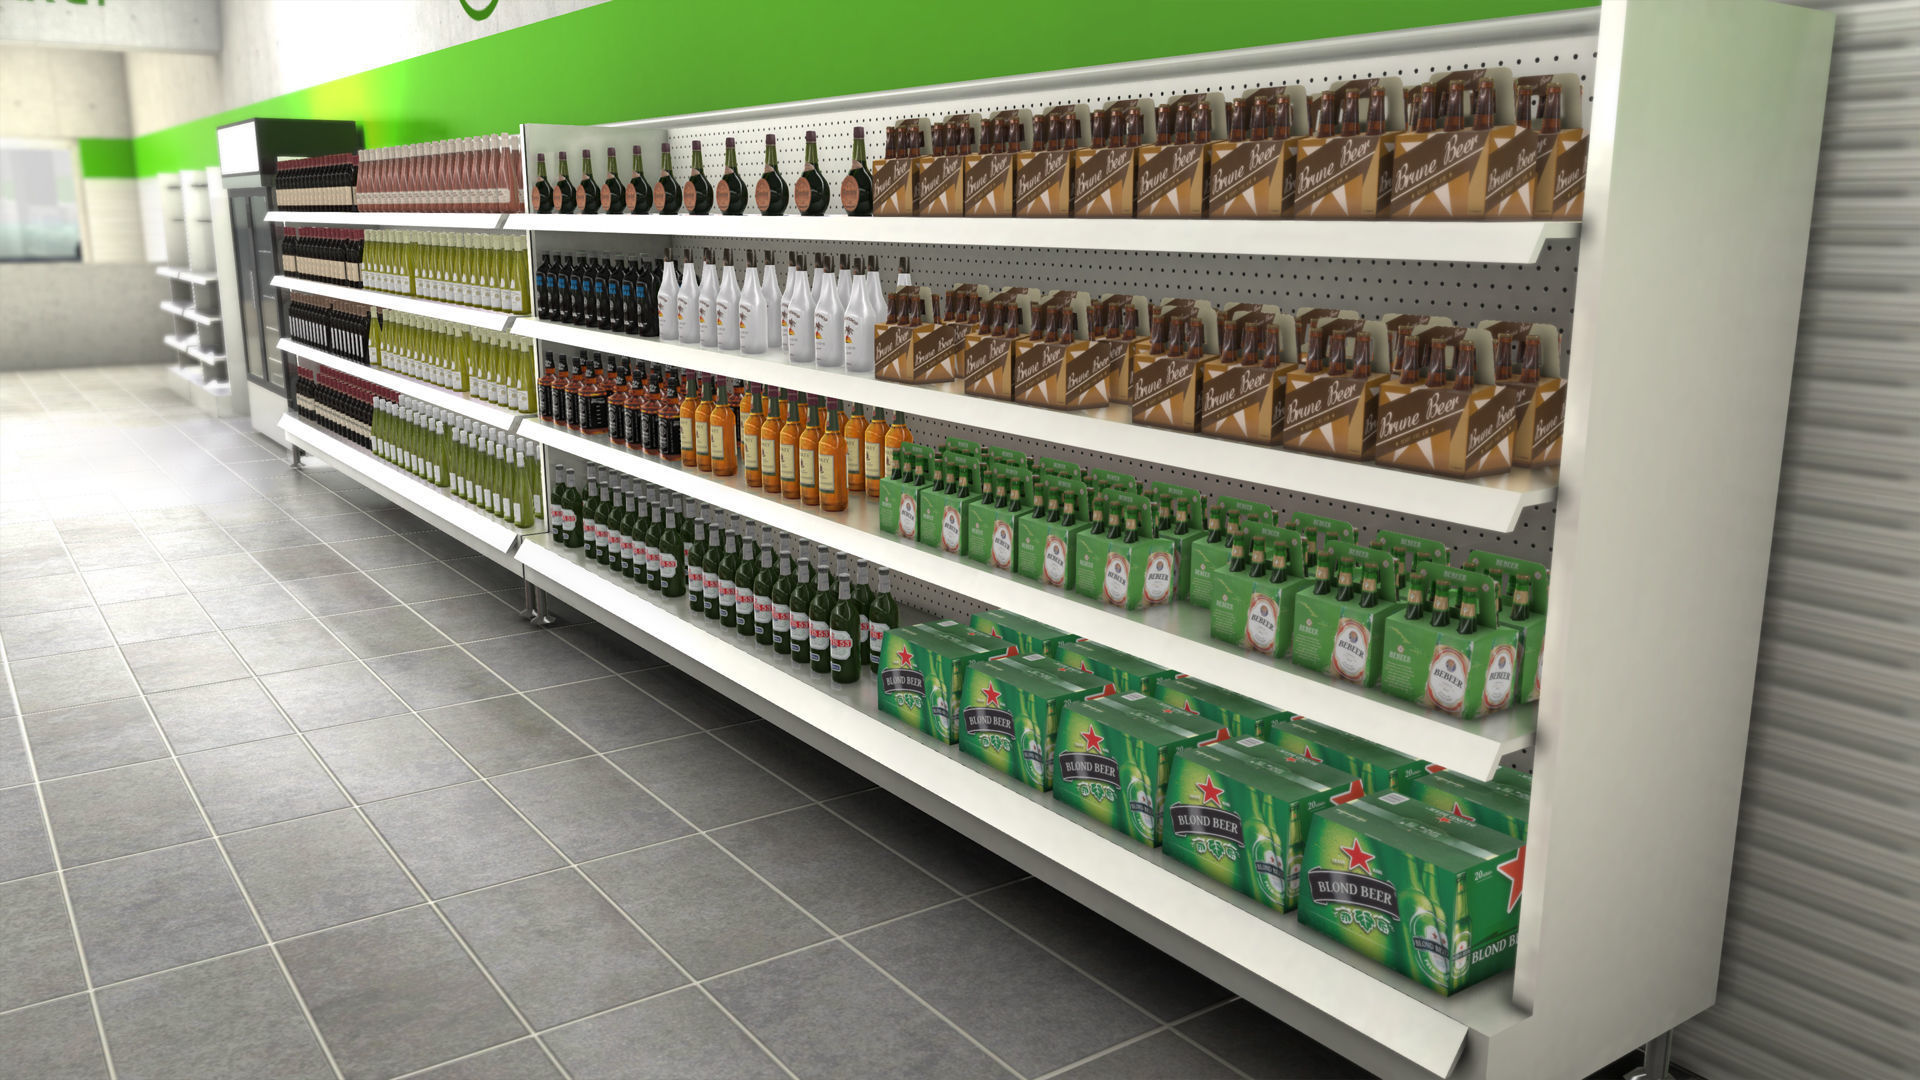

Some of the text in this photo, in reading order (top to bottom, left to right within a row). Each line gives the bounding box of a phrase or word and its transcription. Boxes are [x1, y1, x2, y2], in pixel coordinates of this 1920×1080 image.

[1018, 152, 1064, 196] Brune Beer
[1077, 150, 1127, 196] Brune Beer
[1139, 147, 1196, 195] Brune Beer
[1212, 143, 1276, 195] Brune Beer
[1298, 162, 1335, 194] Brune
[1340, 139, 1371, 169] Beer
[1394, 158, 1437, 193] Brune
[1443, 133, 1479, 166] Beer
[1488, 148, 1536, 192] Brune Beer
[966, 156, 1008, 198] Brune Beer
[1556, 169, 1580, 193] Brune
[966, 339, 1006, 375] Brune Beer
[1016, 346, 1061, 383] Brune Beer
[1067, 356, 1109, 390] Brune Beer
[1134, 360, 1189, 400] Brune Beer
[1204, 369, 1265, 412] Brune Beer
[1286, 398, 1322, 425] Brune
[1327, 379, 1357, 407] Beer
[1379, 411, 1420, 440] Brune
[1426, 392, 1460, 420] Beer
[1468, 405, 1516, 451] Brune Beer
[1534, 416, 1558, 442] Brune
[995, 538, 1010, 551] BEBEER
[1349, 548, 1369, 559] BEBEER
[1401, 537, 1422, 548] BEBEER
[1047, 553, 1064, 567] BEBEER
[1496, 559, 1519, 570] BEBEER
[1108, 571, 1126, 586] BEBEER
[1148, 572, 1169, 582] BEBEER
[1444, 570, 1467, 582] BEBEER
[1250, 614, 1274, 632] BEBEER
[1338, 639, 1364, 659] BEBEER
[1389, 651, 1411, 663] BEBEER
[886, 675, 922, 688] BLOND BEER
[1433, 668, 1464, 689] BEBEER
[1489, 671, 1511, 681] BEBEER
[969, 716, 1012, 729] BLOND BEER
[1066, 761, 1116, 778] BLOND BEER
[1178, 814, 1239, 835] BLOND BEER
[1474, 870, 1483, 881] 20
[1318, 880, 1393, 906] BLOND BEER
[1471, 939, 1507, 965] BLOND
